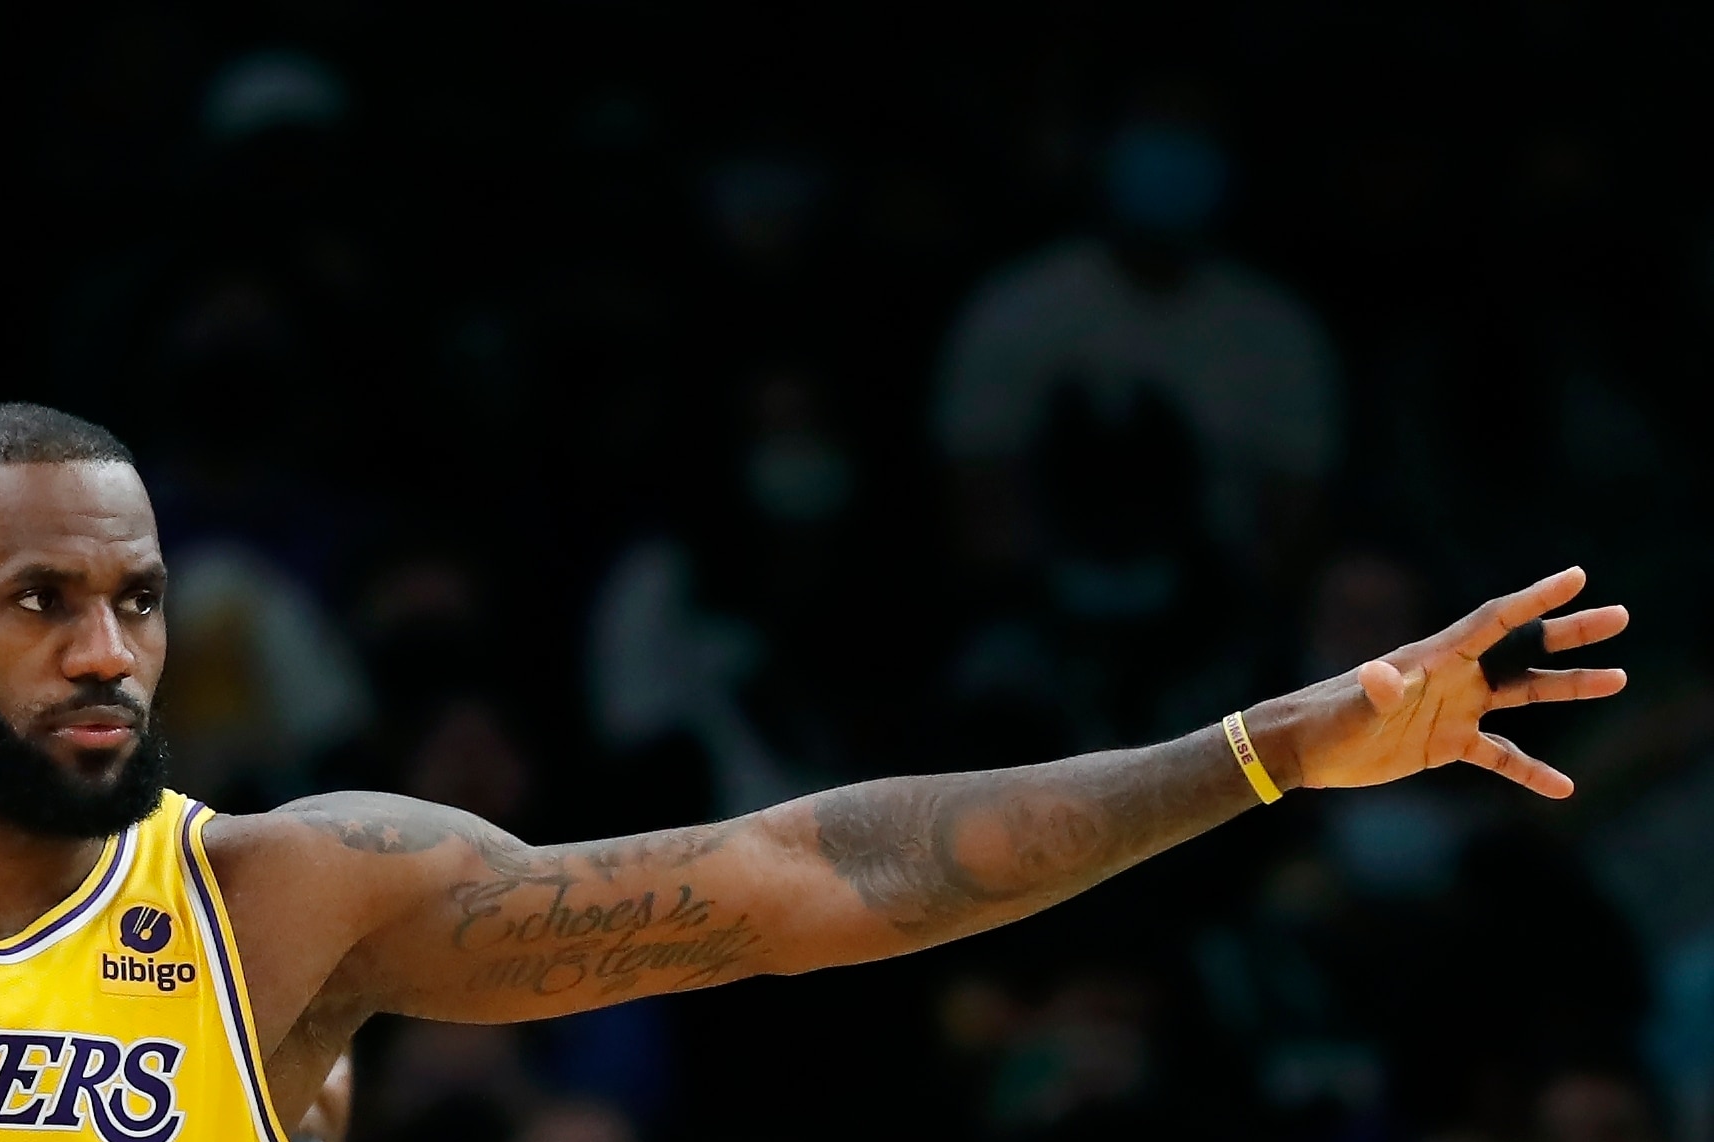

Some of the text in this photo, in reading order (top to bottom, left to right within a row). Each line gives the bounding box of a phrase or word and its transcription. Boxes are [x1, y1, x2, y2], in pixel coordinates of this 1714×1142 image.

[1227, 715, 1253, 765] OMISE
[449, 875, 656, 951] Echoes
[102, 953, 196, 992] bibigo
